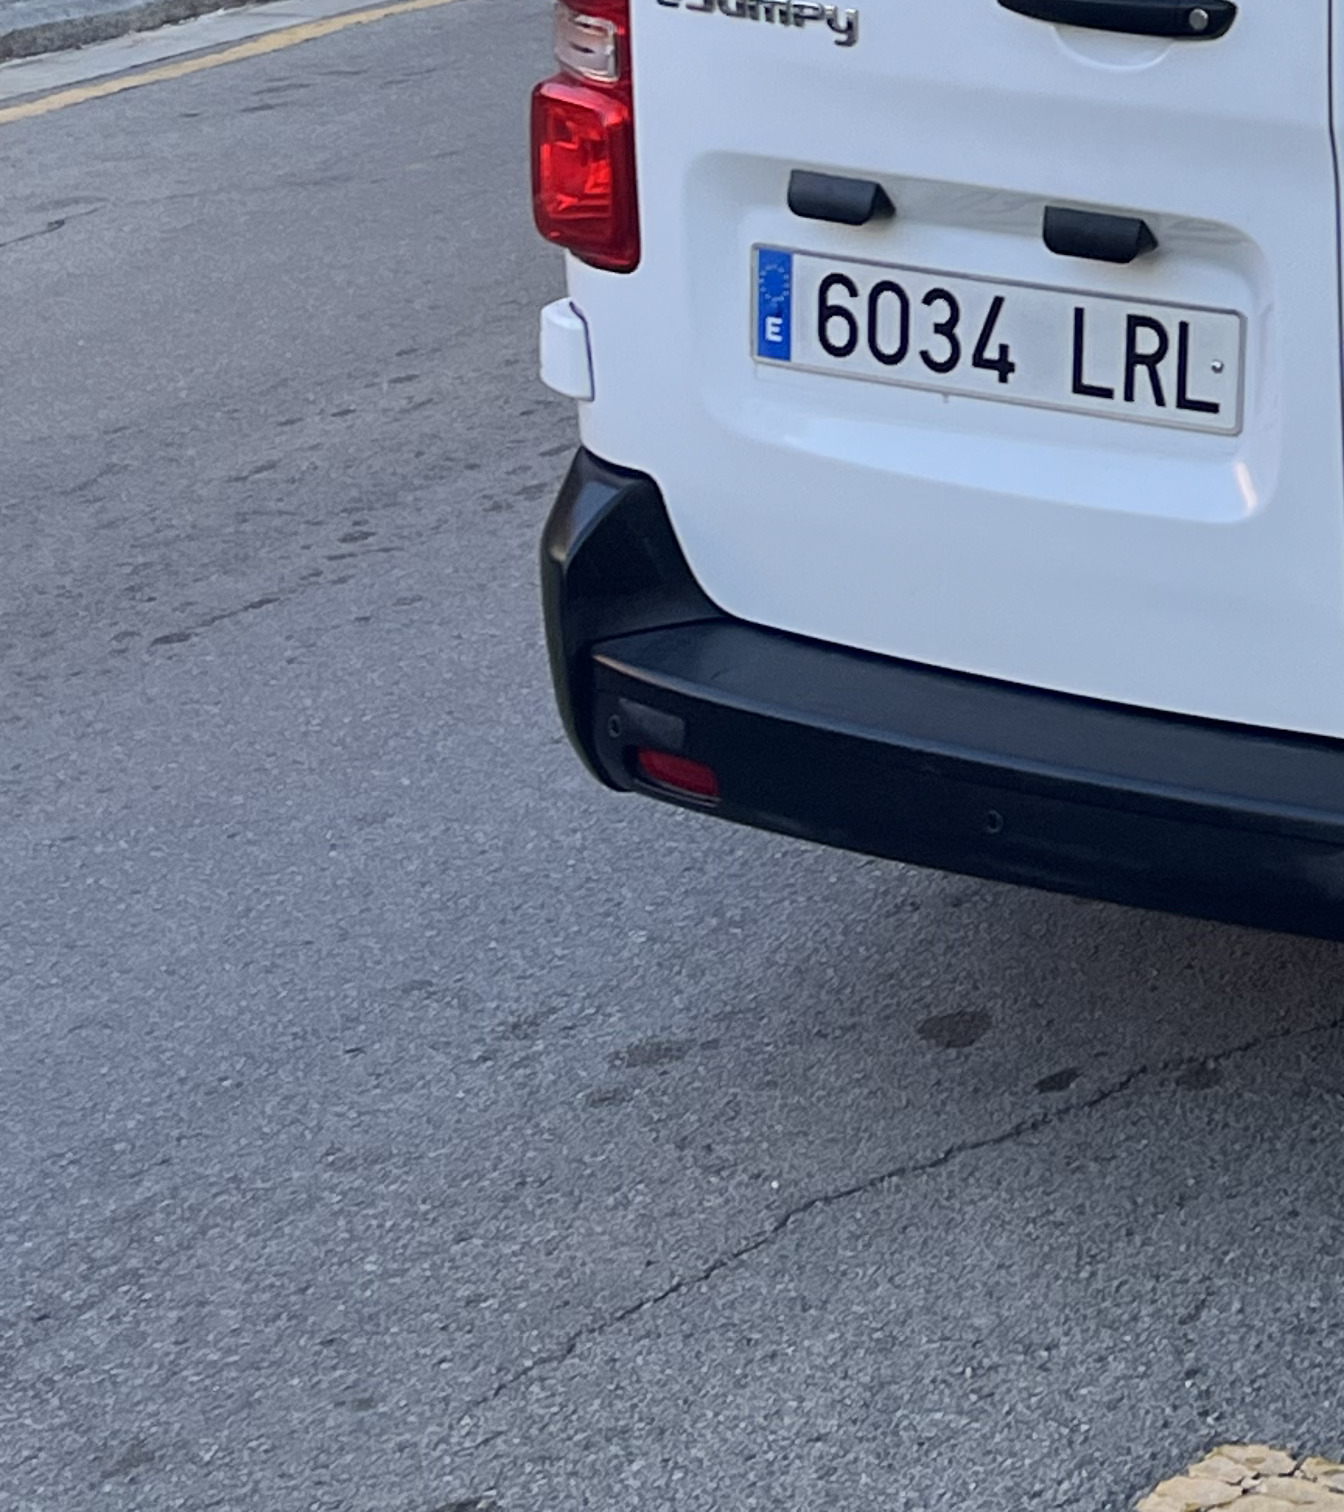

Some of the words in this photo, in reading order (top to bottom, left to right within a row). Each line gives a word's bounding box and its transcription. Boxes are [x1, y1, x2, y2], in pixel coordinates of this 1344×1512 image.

[764, 316, 782, 343] E
[816, 271, 1015, 384] 6034
[1070, 305, 1221, 415] LRL
